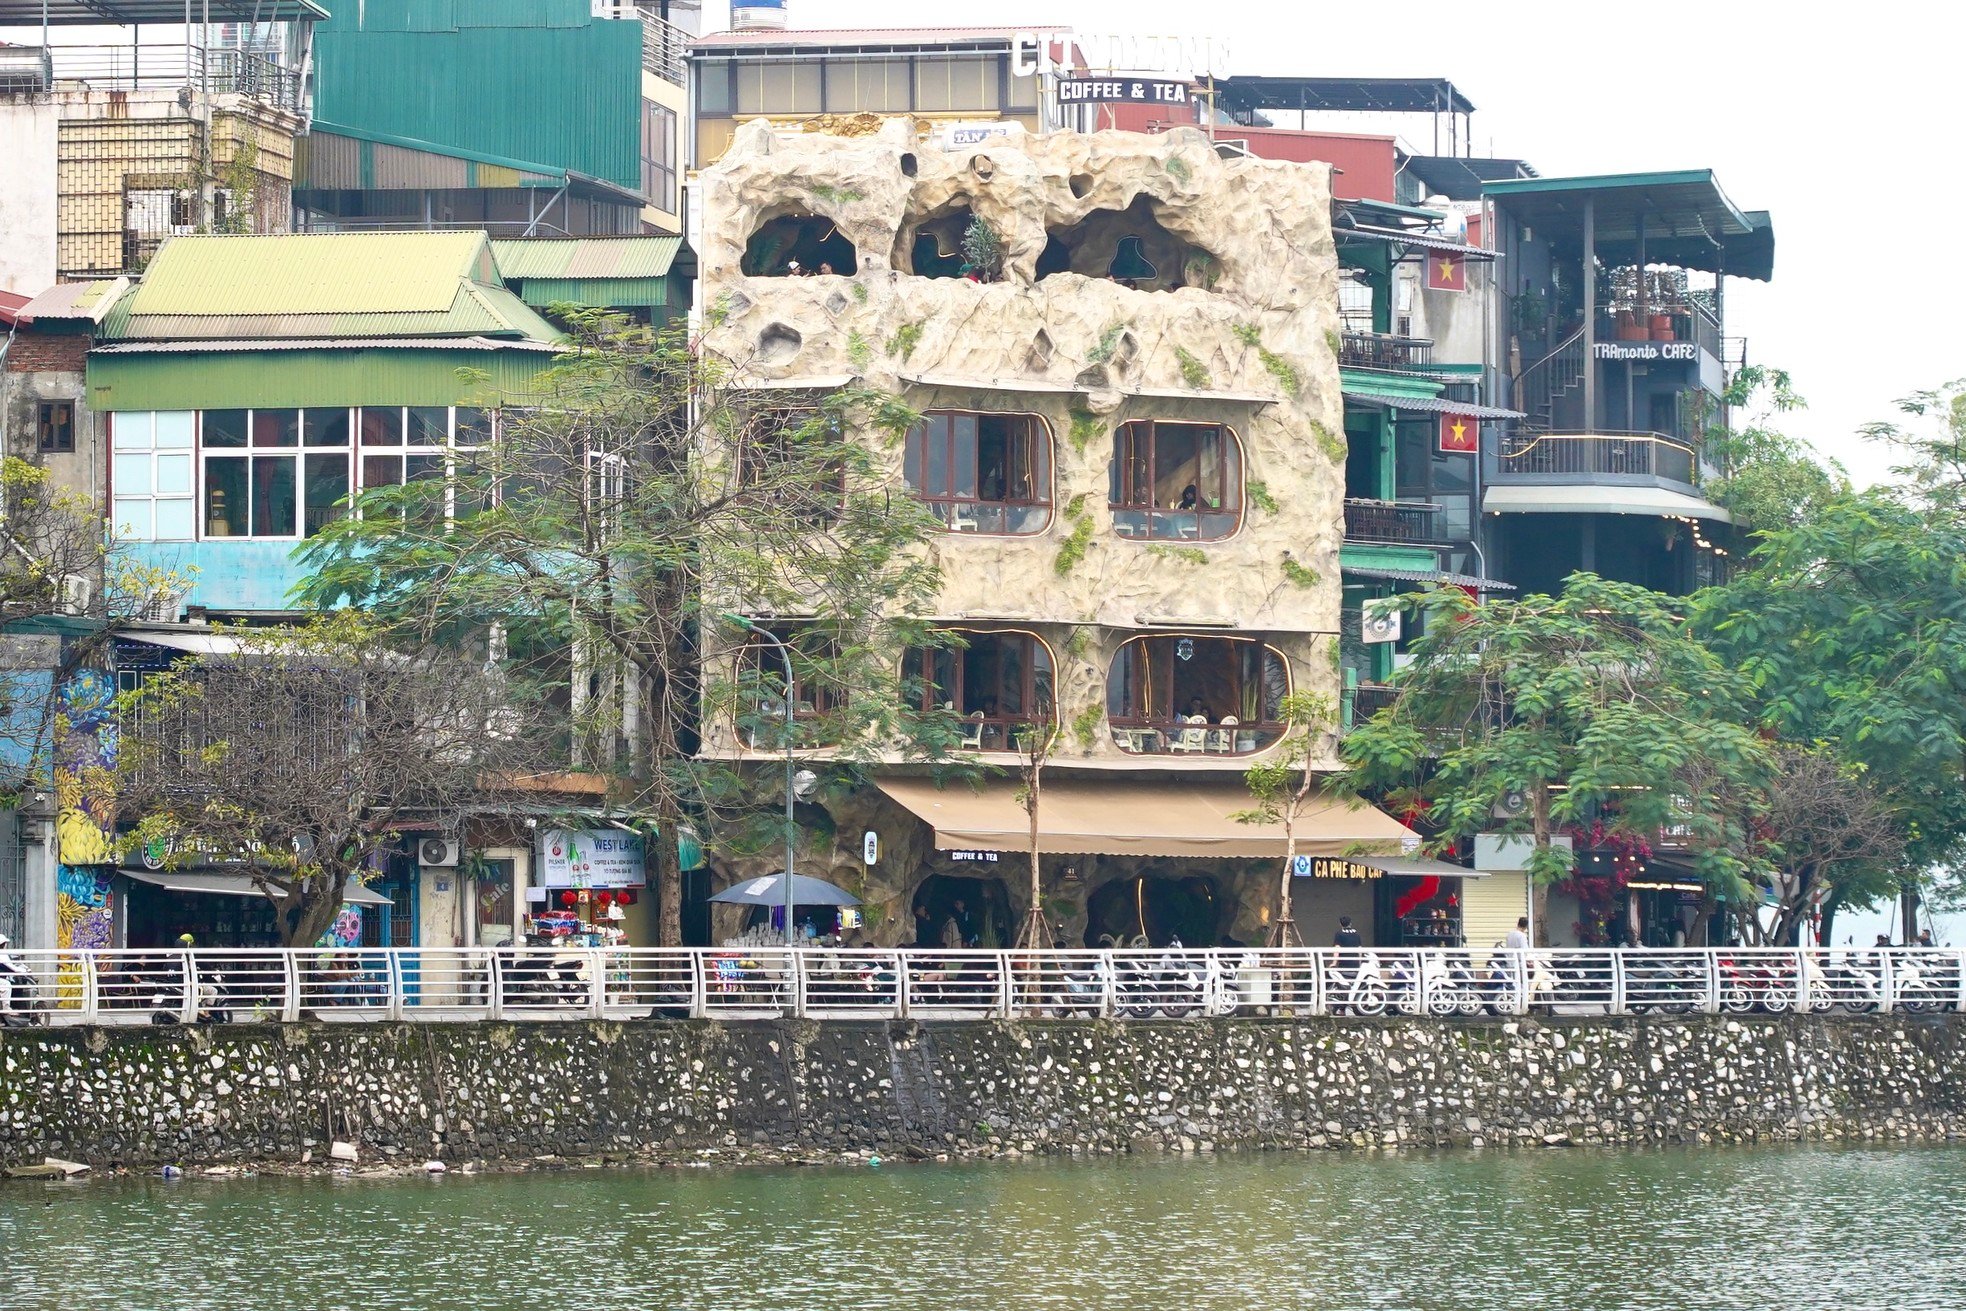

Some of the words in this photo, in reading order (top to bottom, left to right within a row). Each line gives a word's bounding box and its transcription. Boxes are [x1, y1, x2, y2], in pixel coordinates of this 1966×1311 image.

[1060, 82, 1122, 100] COFFEE
[1131, 83, 1145, 99] &
[1153, 84, 1186, 103] TEA
[594, 839, 616, 850] WEST
[952, 852, 976, 860] COFFEE
[986, 853, 998, 862] TEA
